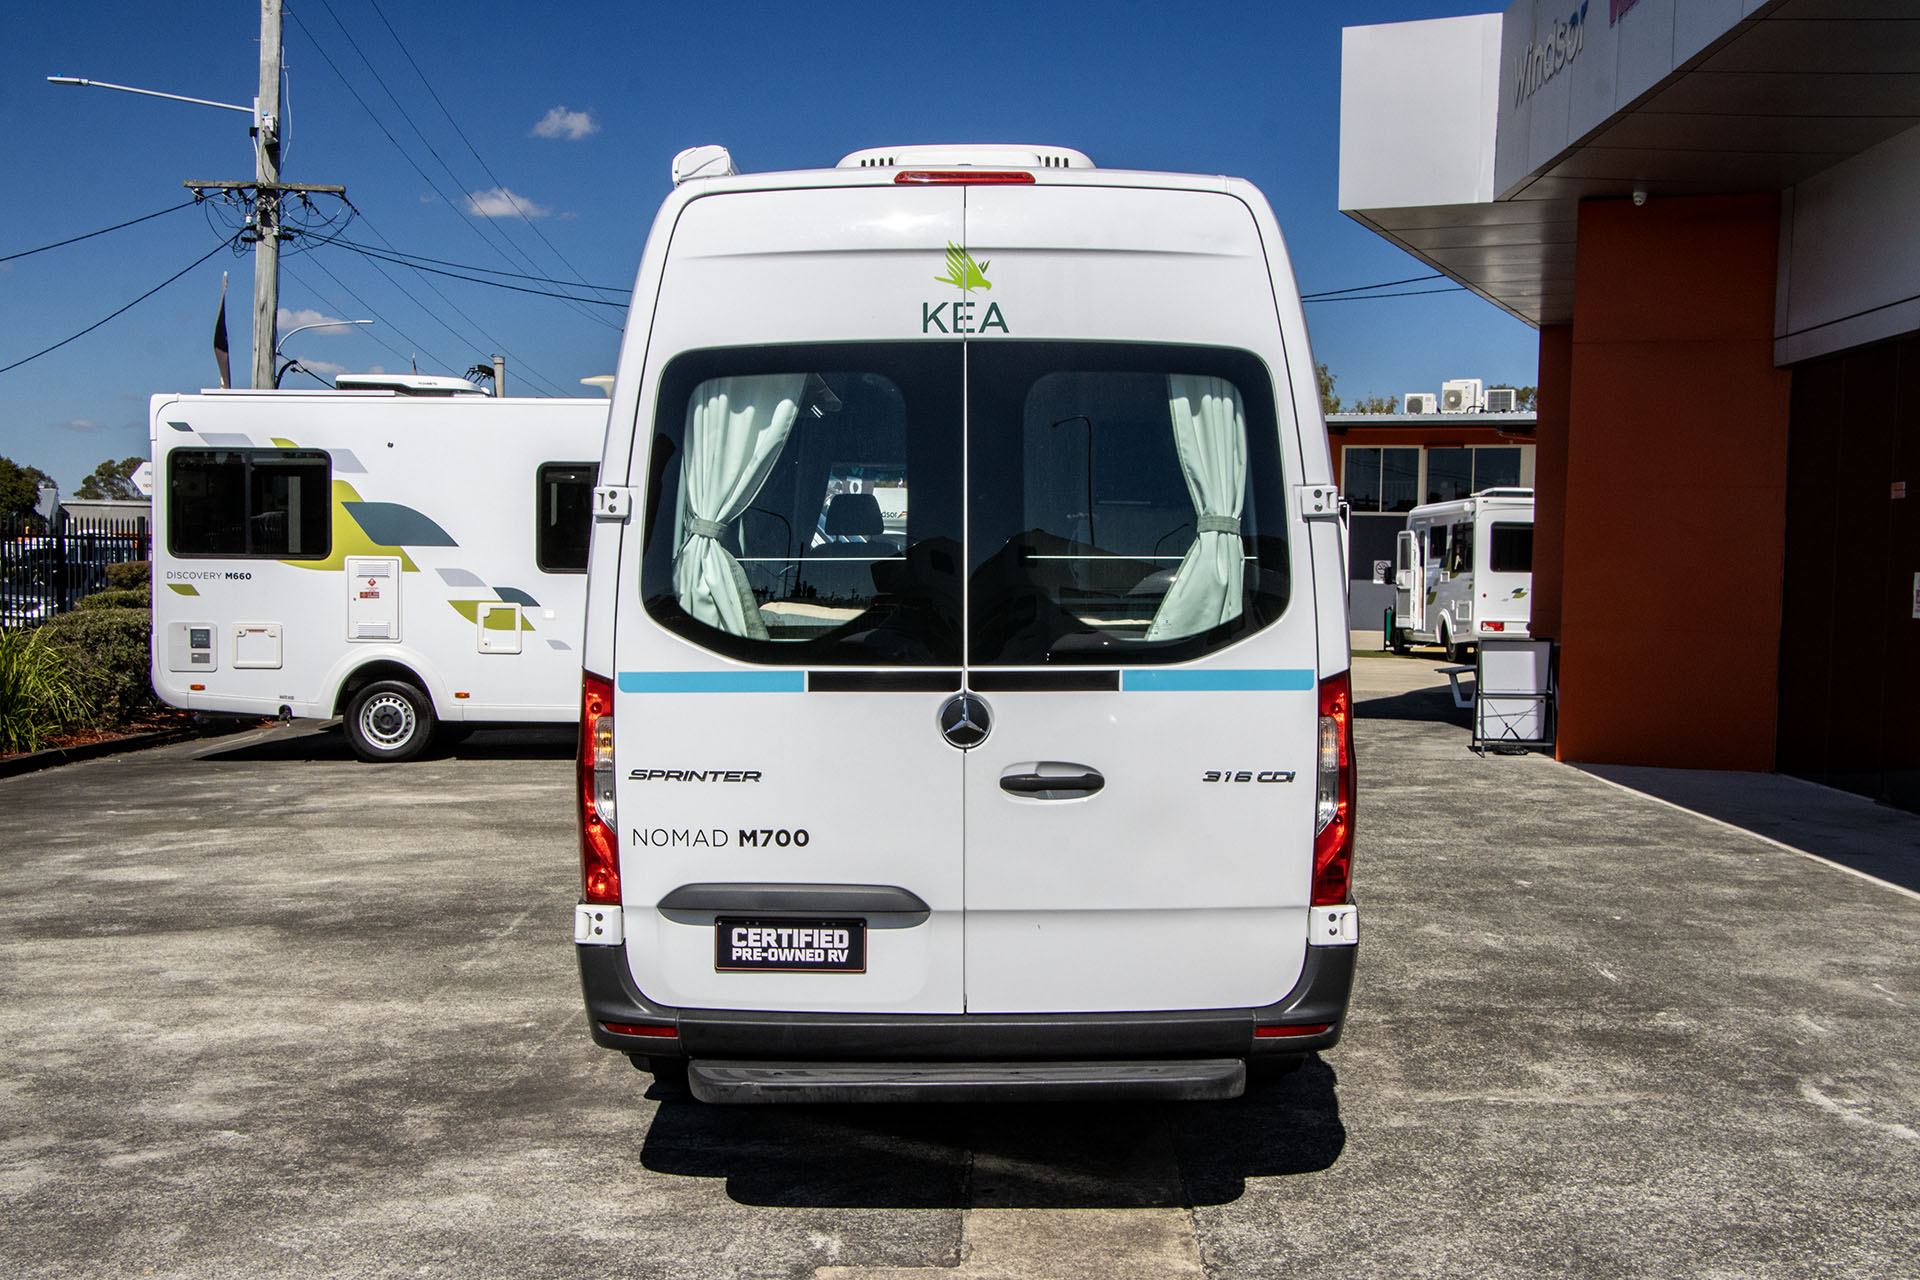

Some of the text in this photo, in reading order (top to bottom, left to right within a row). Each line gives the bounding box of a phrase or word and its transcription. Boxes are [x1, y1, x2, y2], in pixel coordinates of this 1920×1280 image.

[1513, 0, 1588, 109] Windsor
[922, 301, 1009, 333] KEA
[166, 571, 252, 580] DISCOVERY M660
[628, 769, 762, 782] SPRINTER
[1202, 771, 1296, 783] 316 CDI
[632, 828, 809, 847] NOMAD M700
[731, 927, 849, 949] CERTIFIED
[731, 947, 849, 962] PRE-OWNED RV
